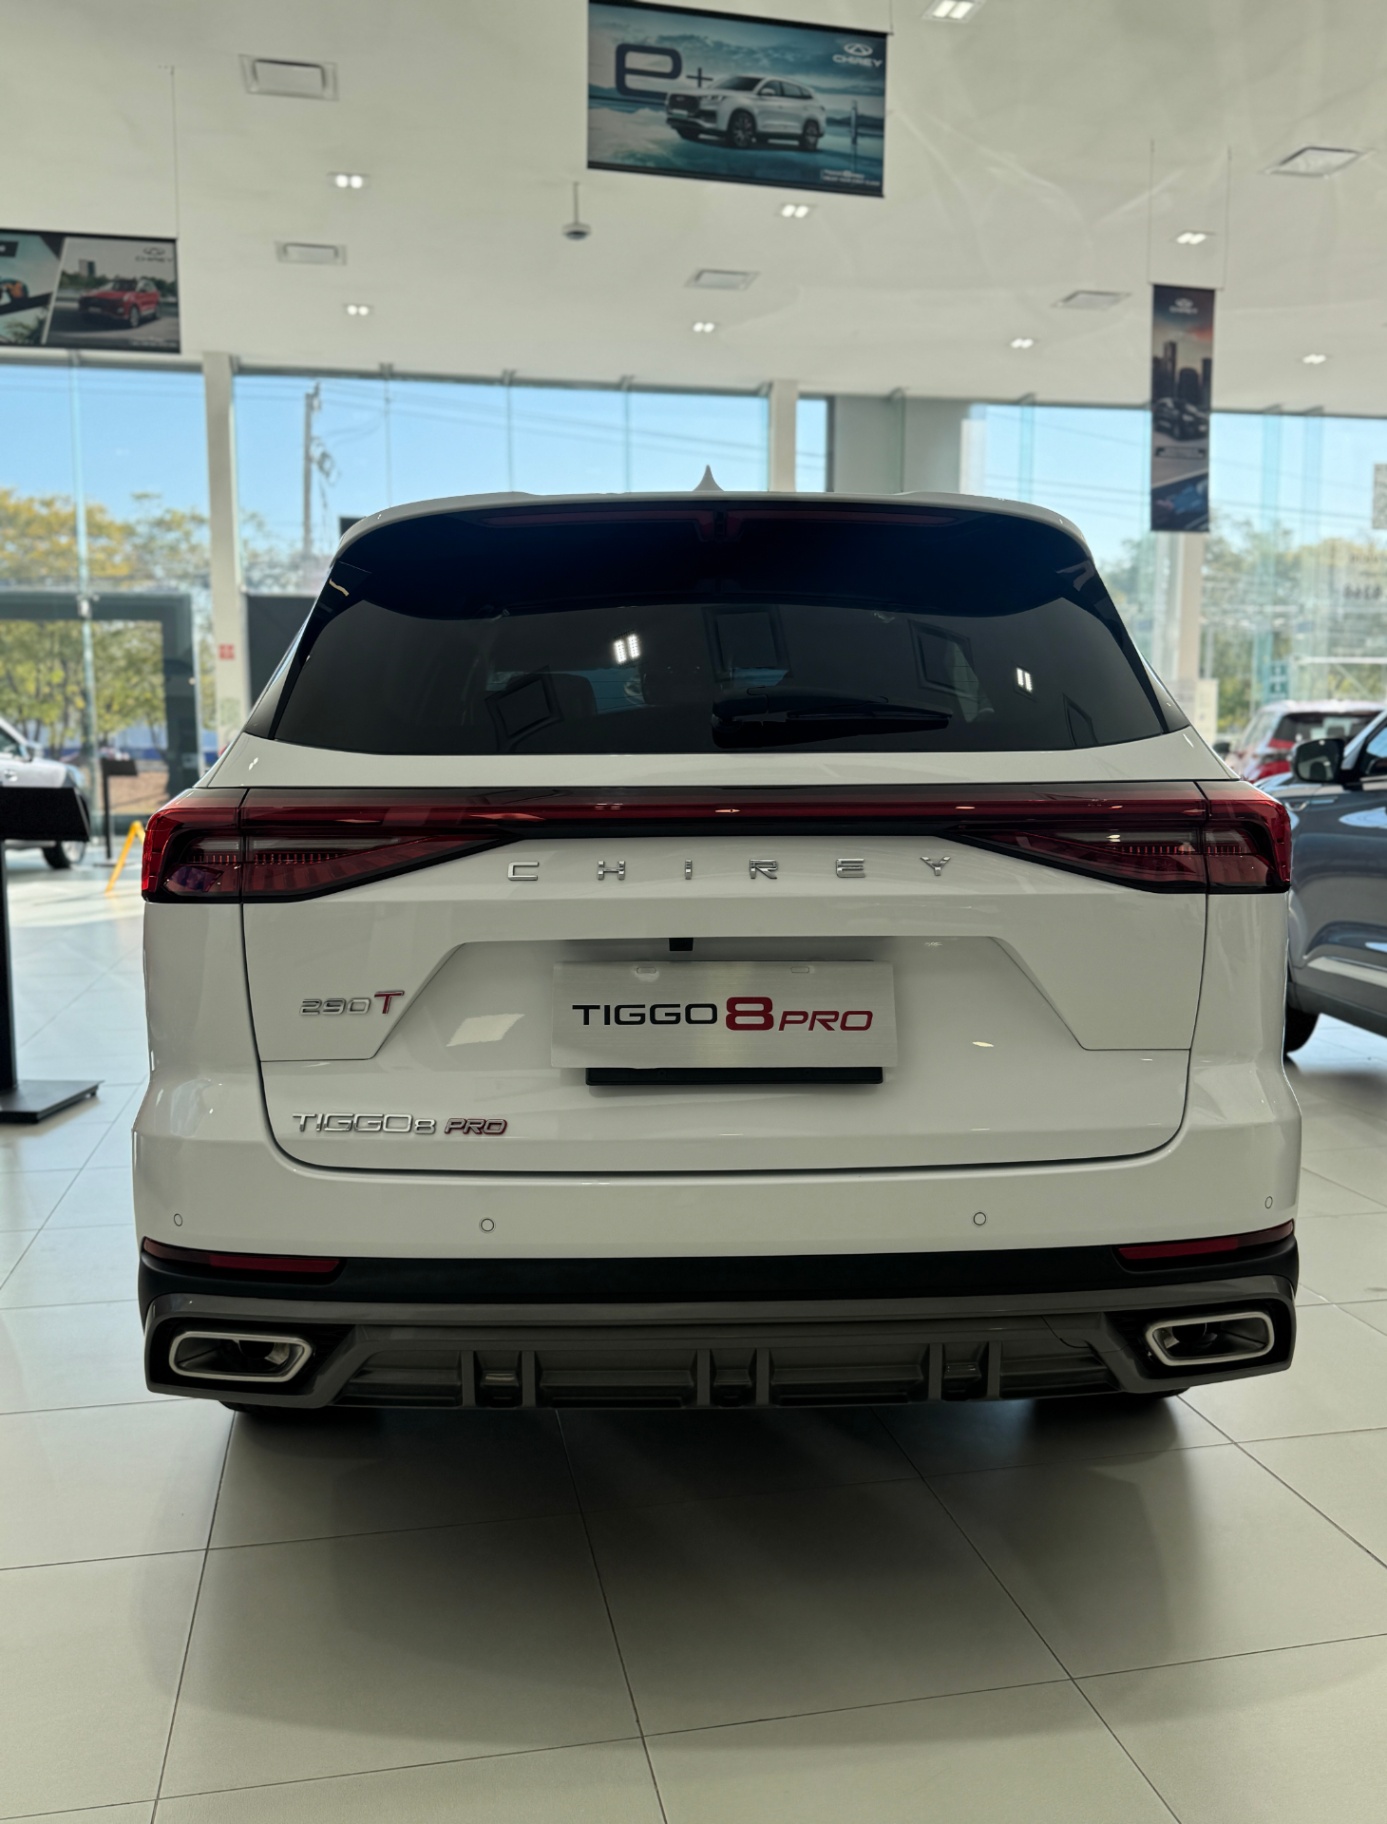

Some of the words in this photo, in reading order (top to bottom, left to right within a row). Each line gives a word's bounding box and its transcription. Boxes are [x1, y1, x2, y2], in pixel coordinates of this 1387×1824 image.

[507, 856, 951, 881] CHIREY
[300, 990, 405, 1016] 290T
[444, 1118, 508, 1135] PRO
